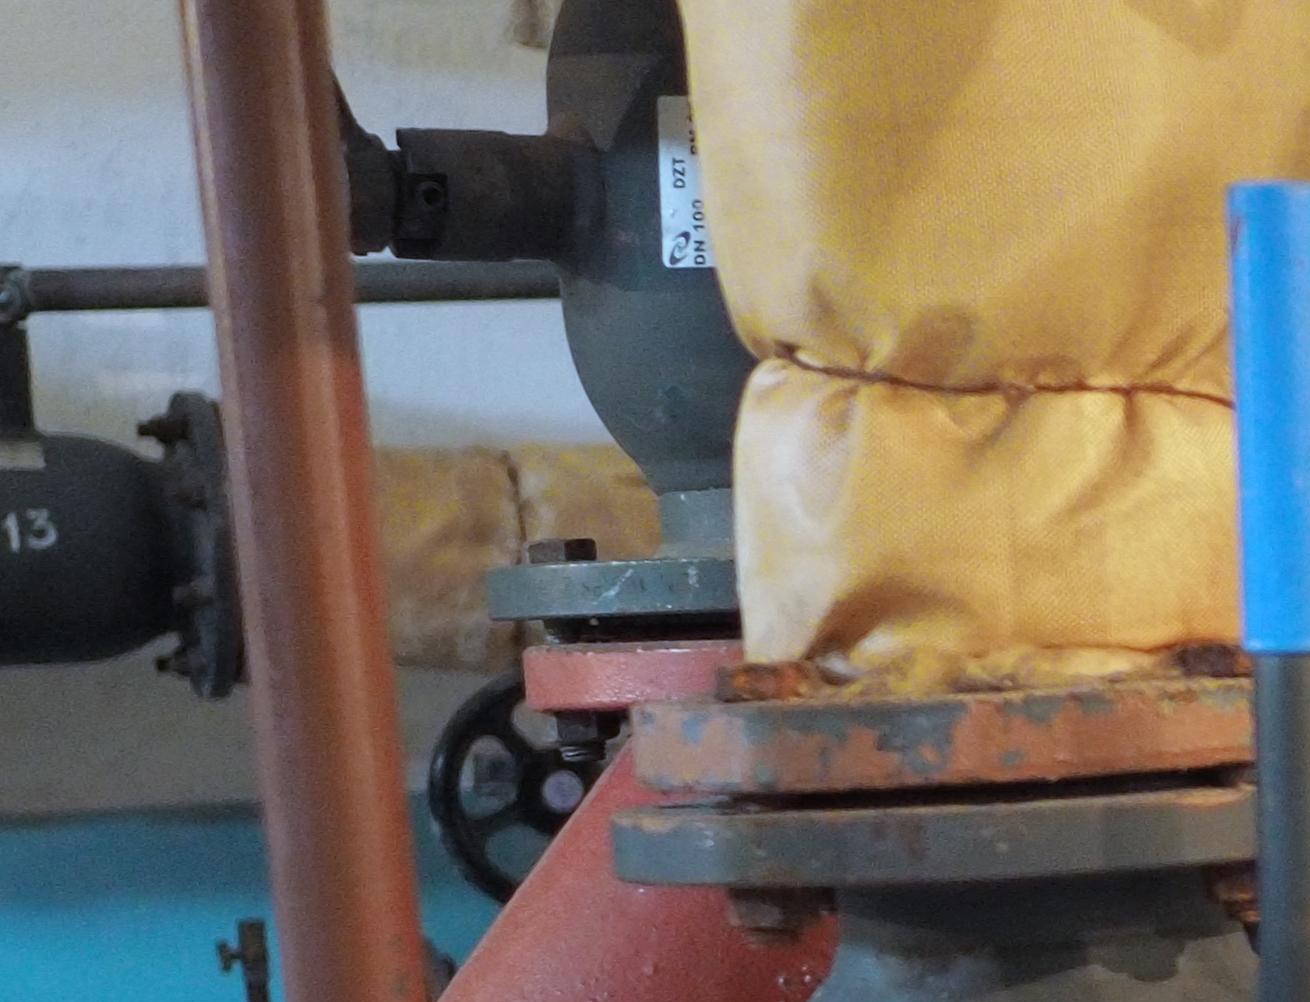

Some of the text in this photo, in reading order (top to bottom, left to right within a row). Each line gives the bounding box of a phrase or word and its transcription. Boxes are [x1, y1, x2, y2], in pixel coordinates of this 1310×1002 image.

[672, 157, 686, 189] DZT
[692, 200, 706, 265] DN 100
[4, 508, 58, 553] 13
